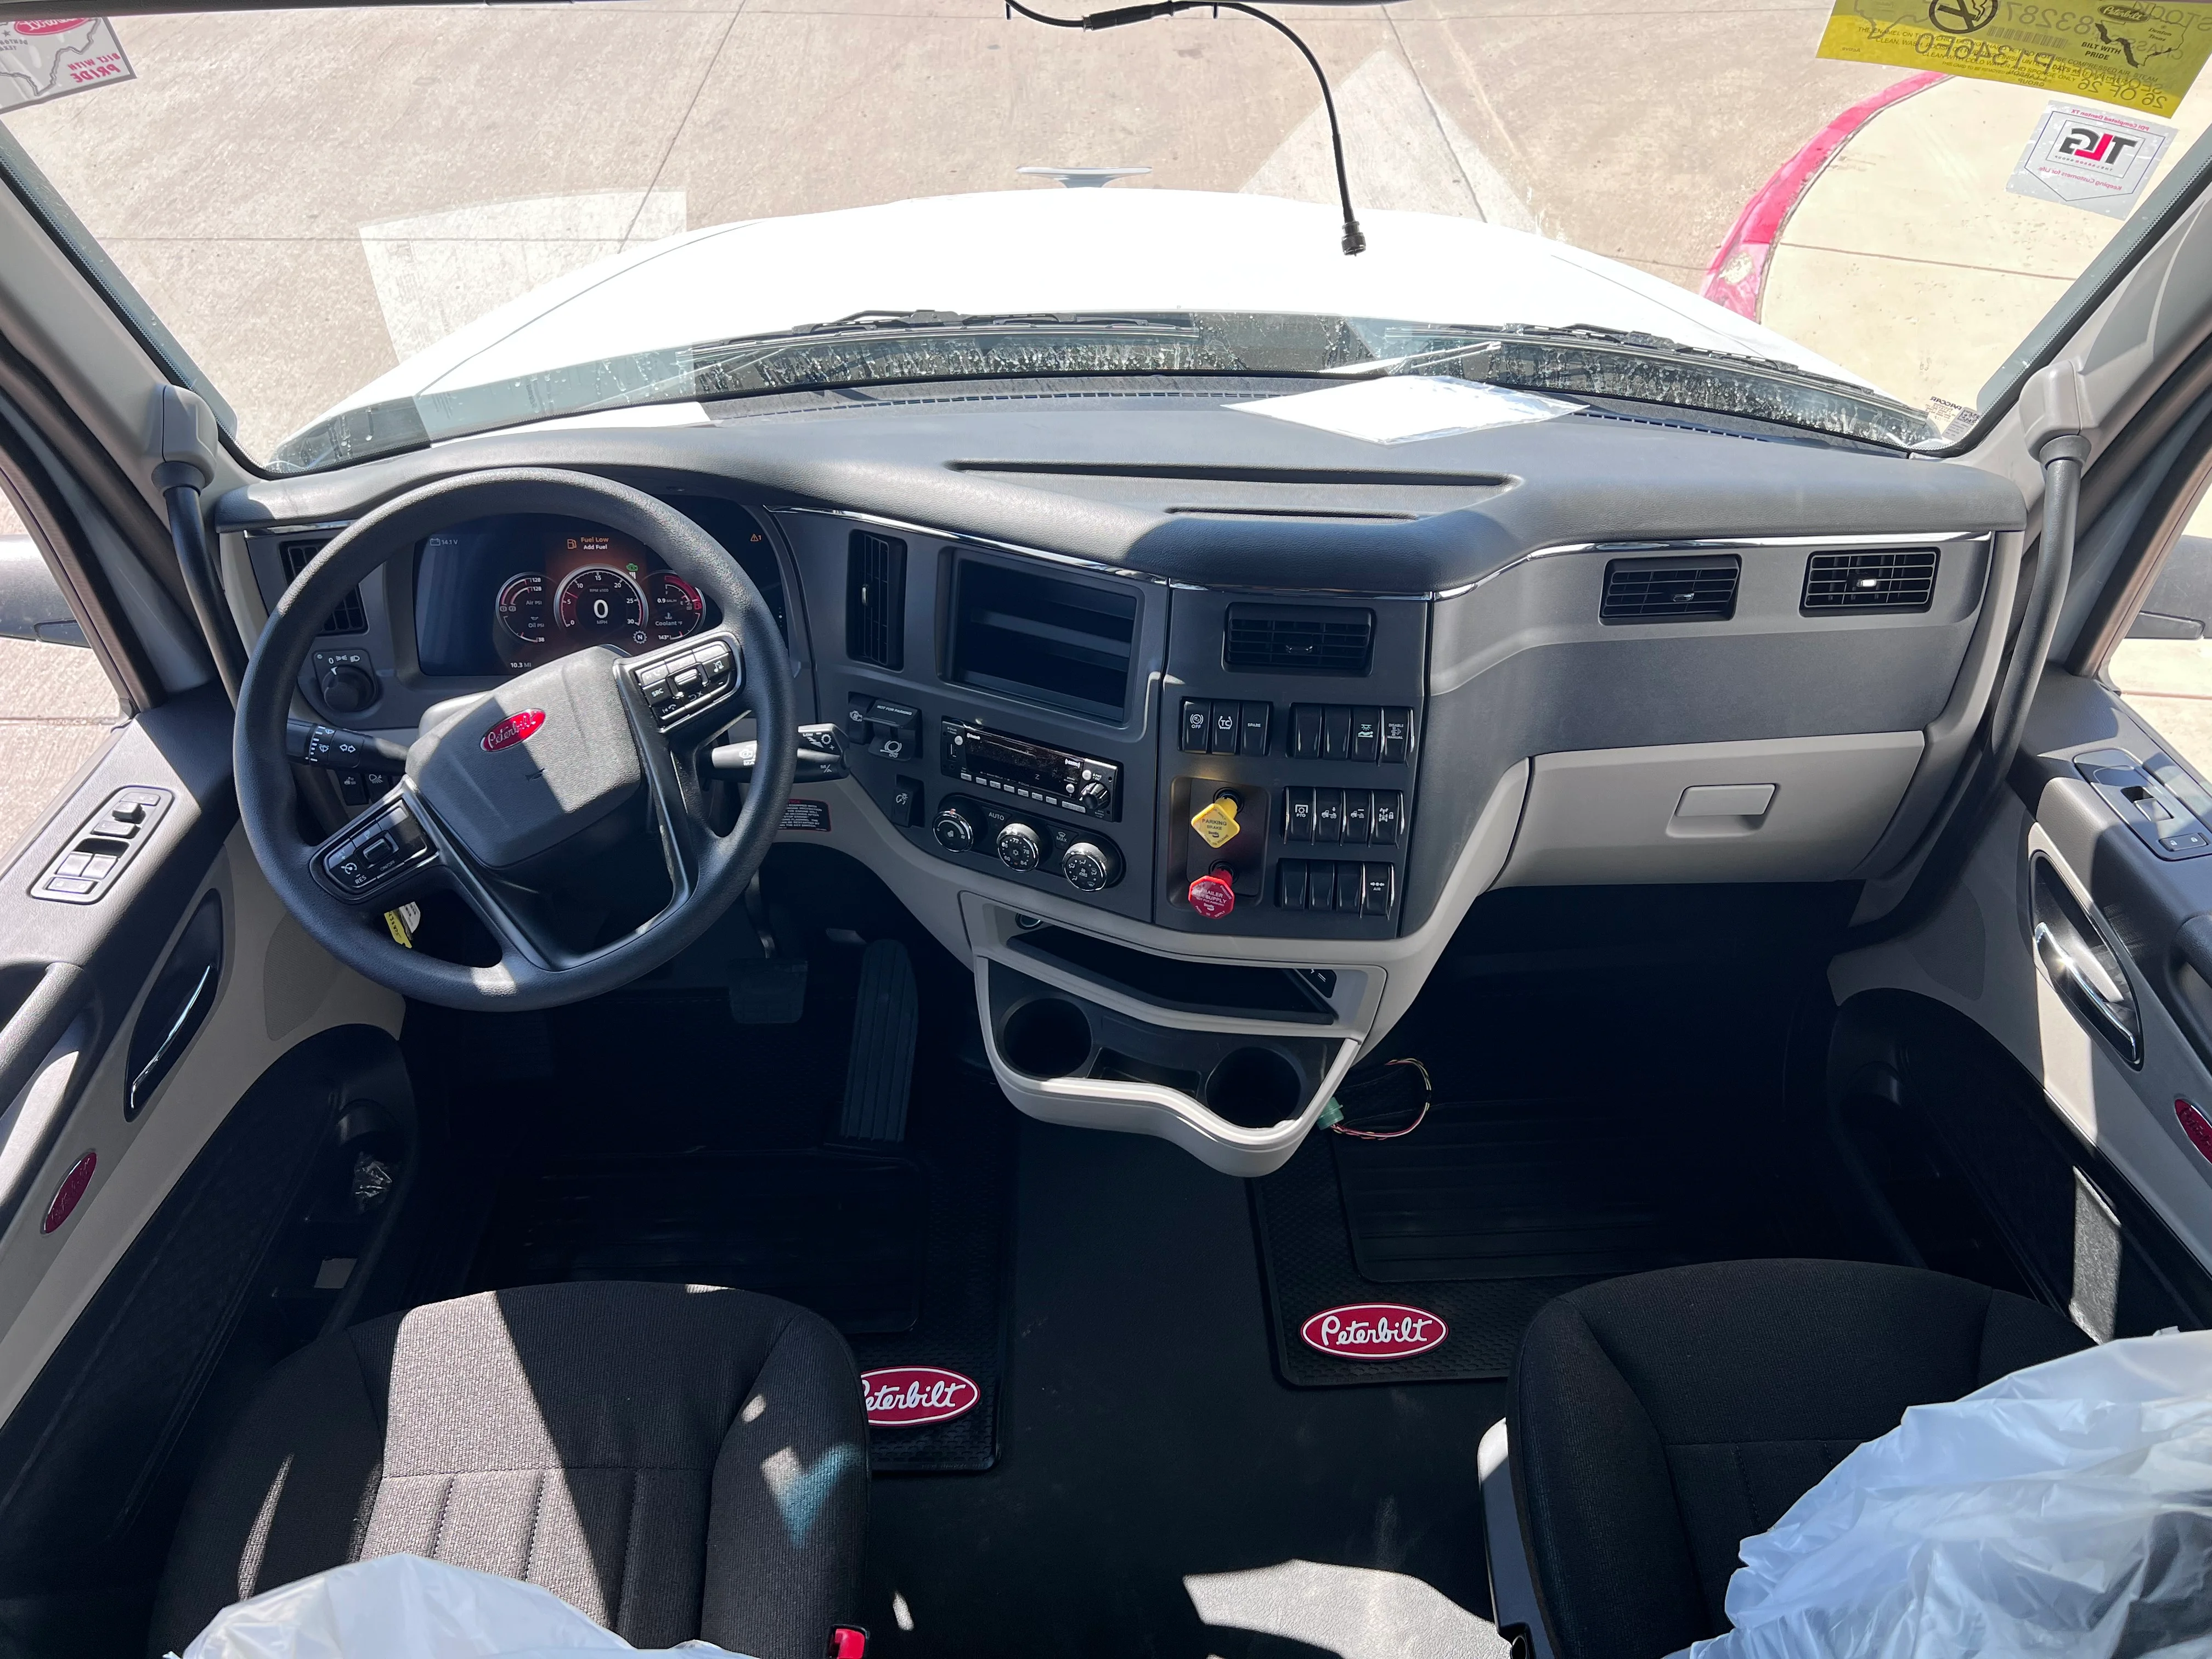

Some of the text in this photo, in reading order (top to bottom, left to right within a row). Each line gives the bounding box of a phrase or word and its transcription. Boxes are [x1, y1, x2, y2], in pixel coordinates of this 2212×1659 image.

[2081, 41, 2122, 55] BILT WITH
[2085, 50, 2110, 61] PRIDE
[2052, 64, 2071, 73] DAYS
[2067, 59, 2118, 74] COMPRESSED
[2132, 72, 2159, 83] STEAM
[2058, 74, 2076, 82] ONLY
[594, 599, 608, 618] 0
[651, 688, 664, 697] SRC
[988, 811, 1005, 821] AUTO
[354, 874, 367, 884] RES
[1205, 894, 1227, 904] SUPPLY
[1321, 1315, 1433, 1346] Peterbilt
